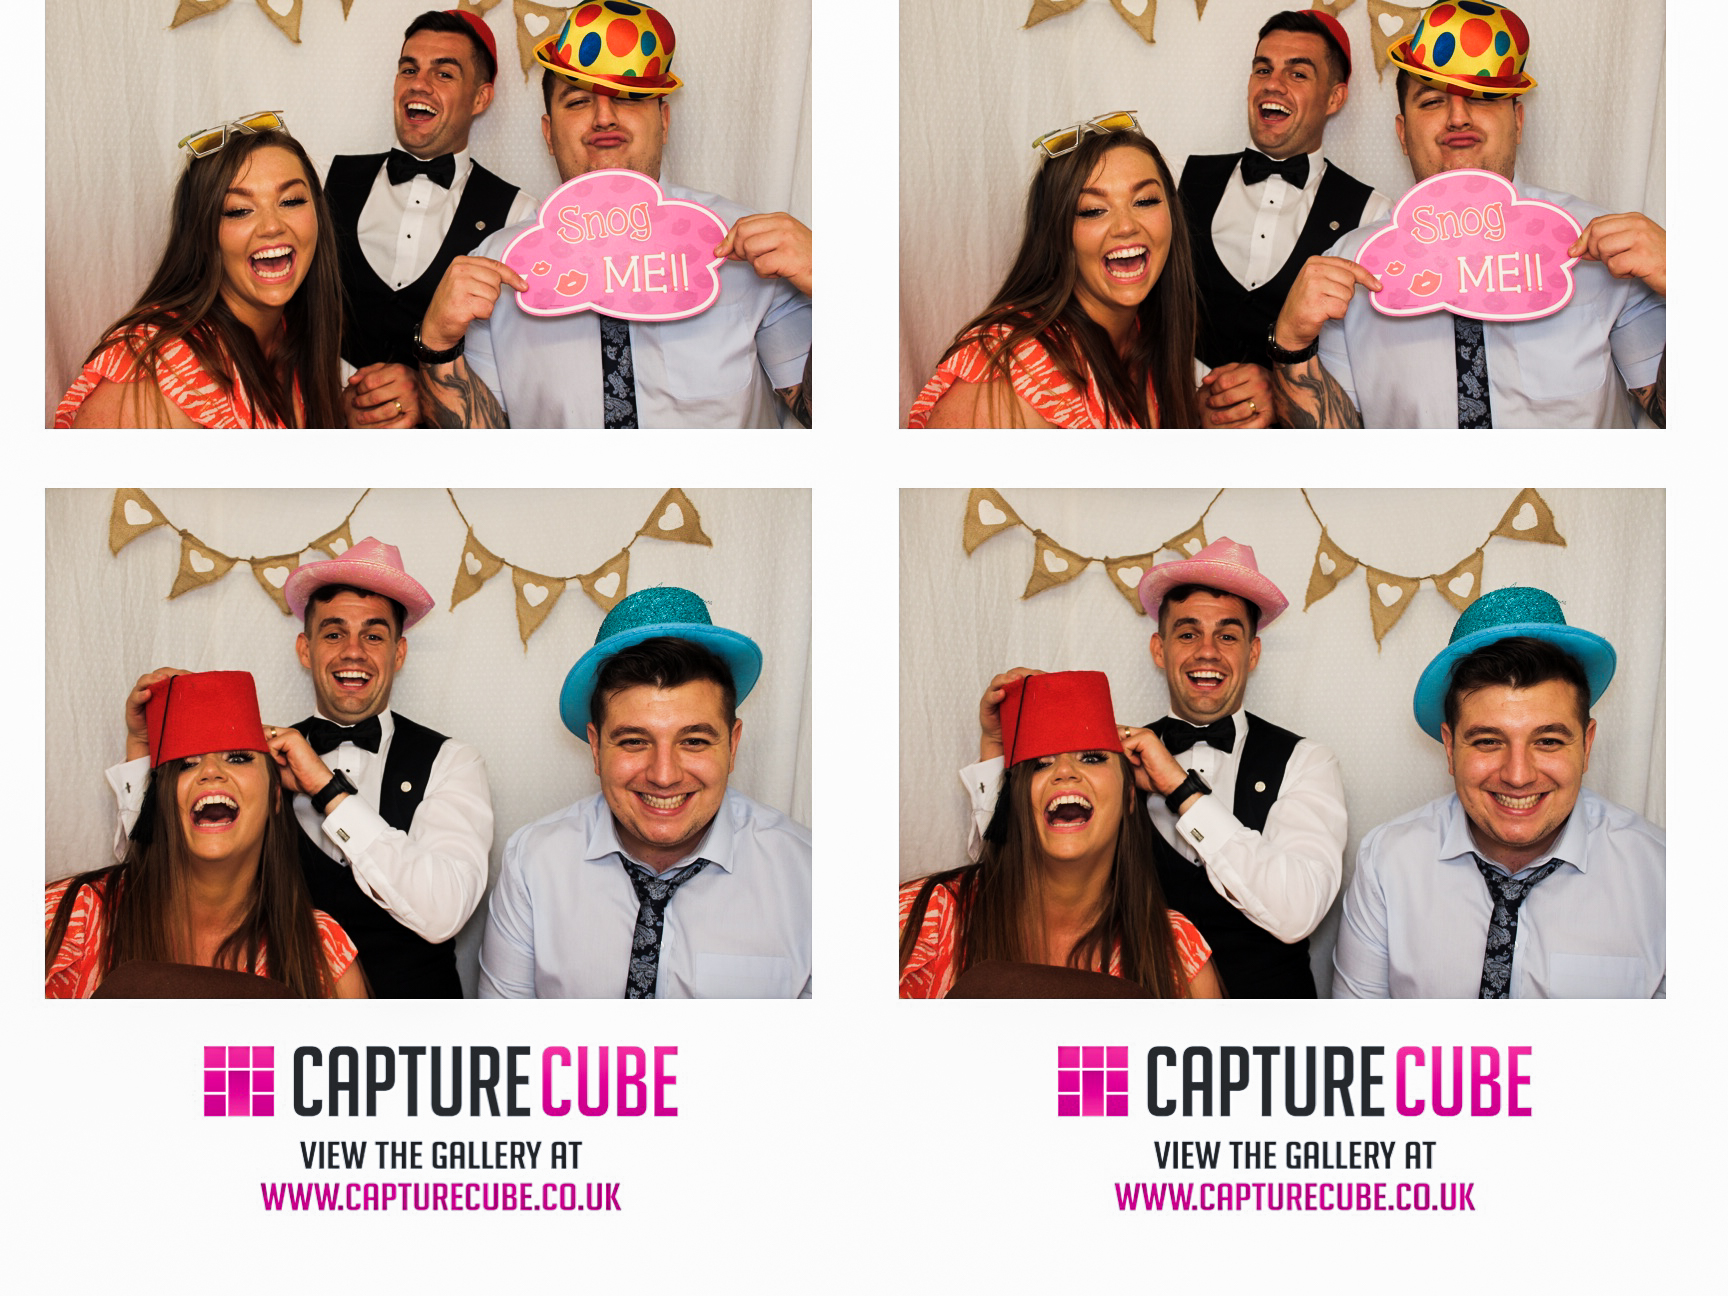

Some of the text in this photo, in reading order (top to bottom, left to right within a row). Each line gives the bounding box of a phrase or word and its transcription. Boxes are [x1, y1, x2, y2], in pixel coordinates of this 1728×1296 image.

[557, 202, 652, 244] Snog
[1411, 202, 1506, 244] Snog
[603, 251, 690, 294] ME!!
[1457, 251, 1544, 294] ME!!
